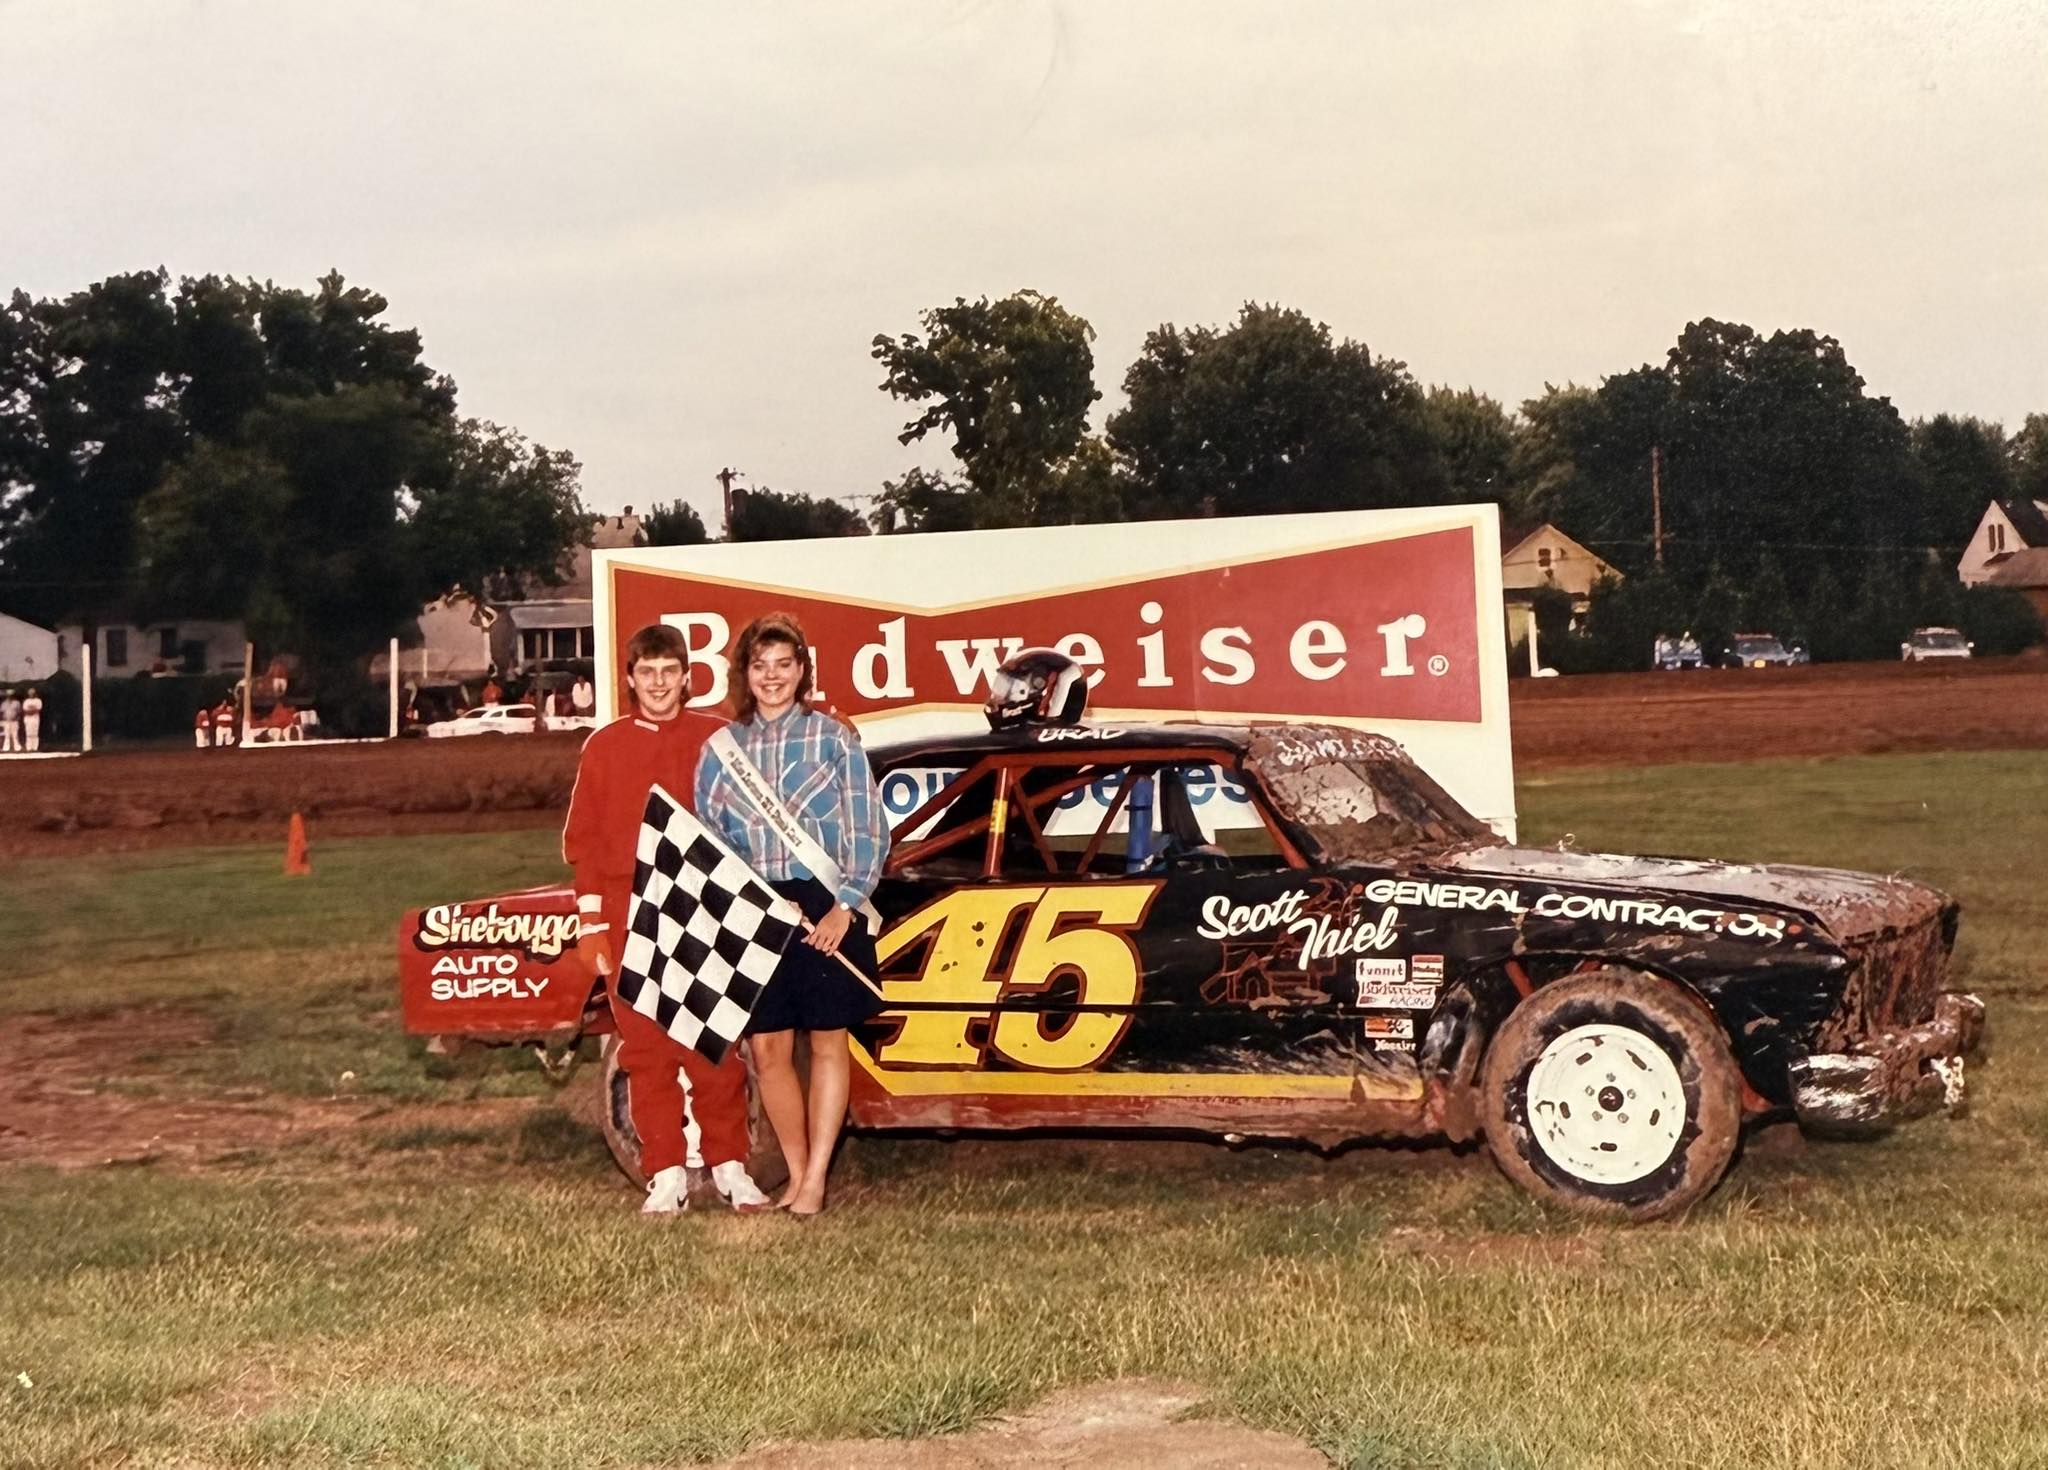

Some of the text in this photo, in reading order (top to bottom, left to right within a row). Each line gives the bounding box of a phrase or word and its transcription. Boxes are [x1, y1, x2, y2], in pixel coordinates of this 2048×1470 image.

[1196, 889, 1310, 939] Scott
[1364, 879, 1530, 914] GENERAL
[1287, 906, 1400, 971] Thiel
[430, 953, 519, 976] AUTO
[873, 881, 1162, 1071] 45
[430, 977, 549, 1001] SUPPLY
